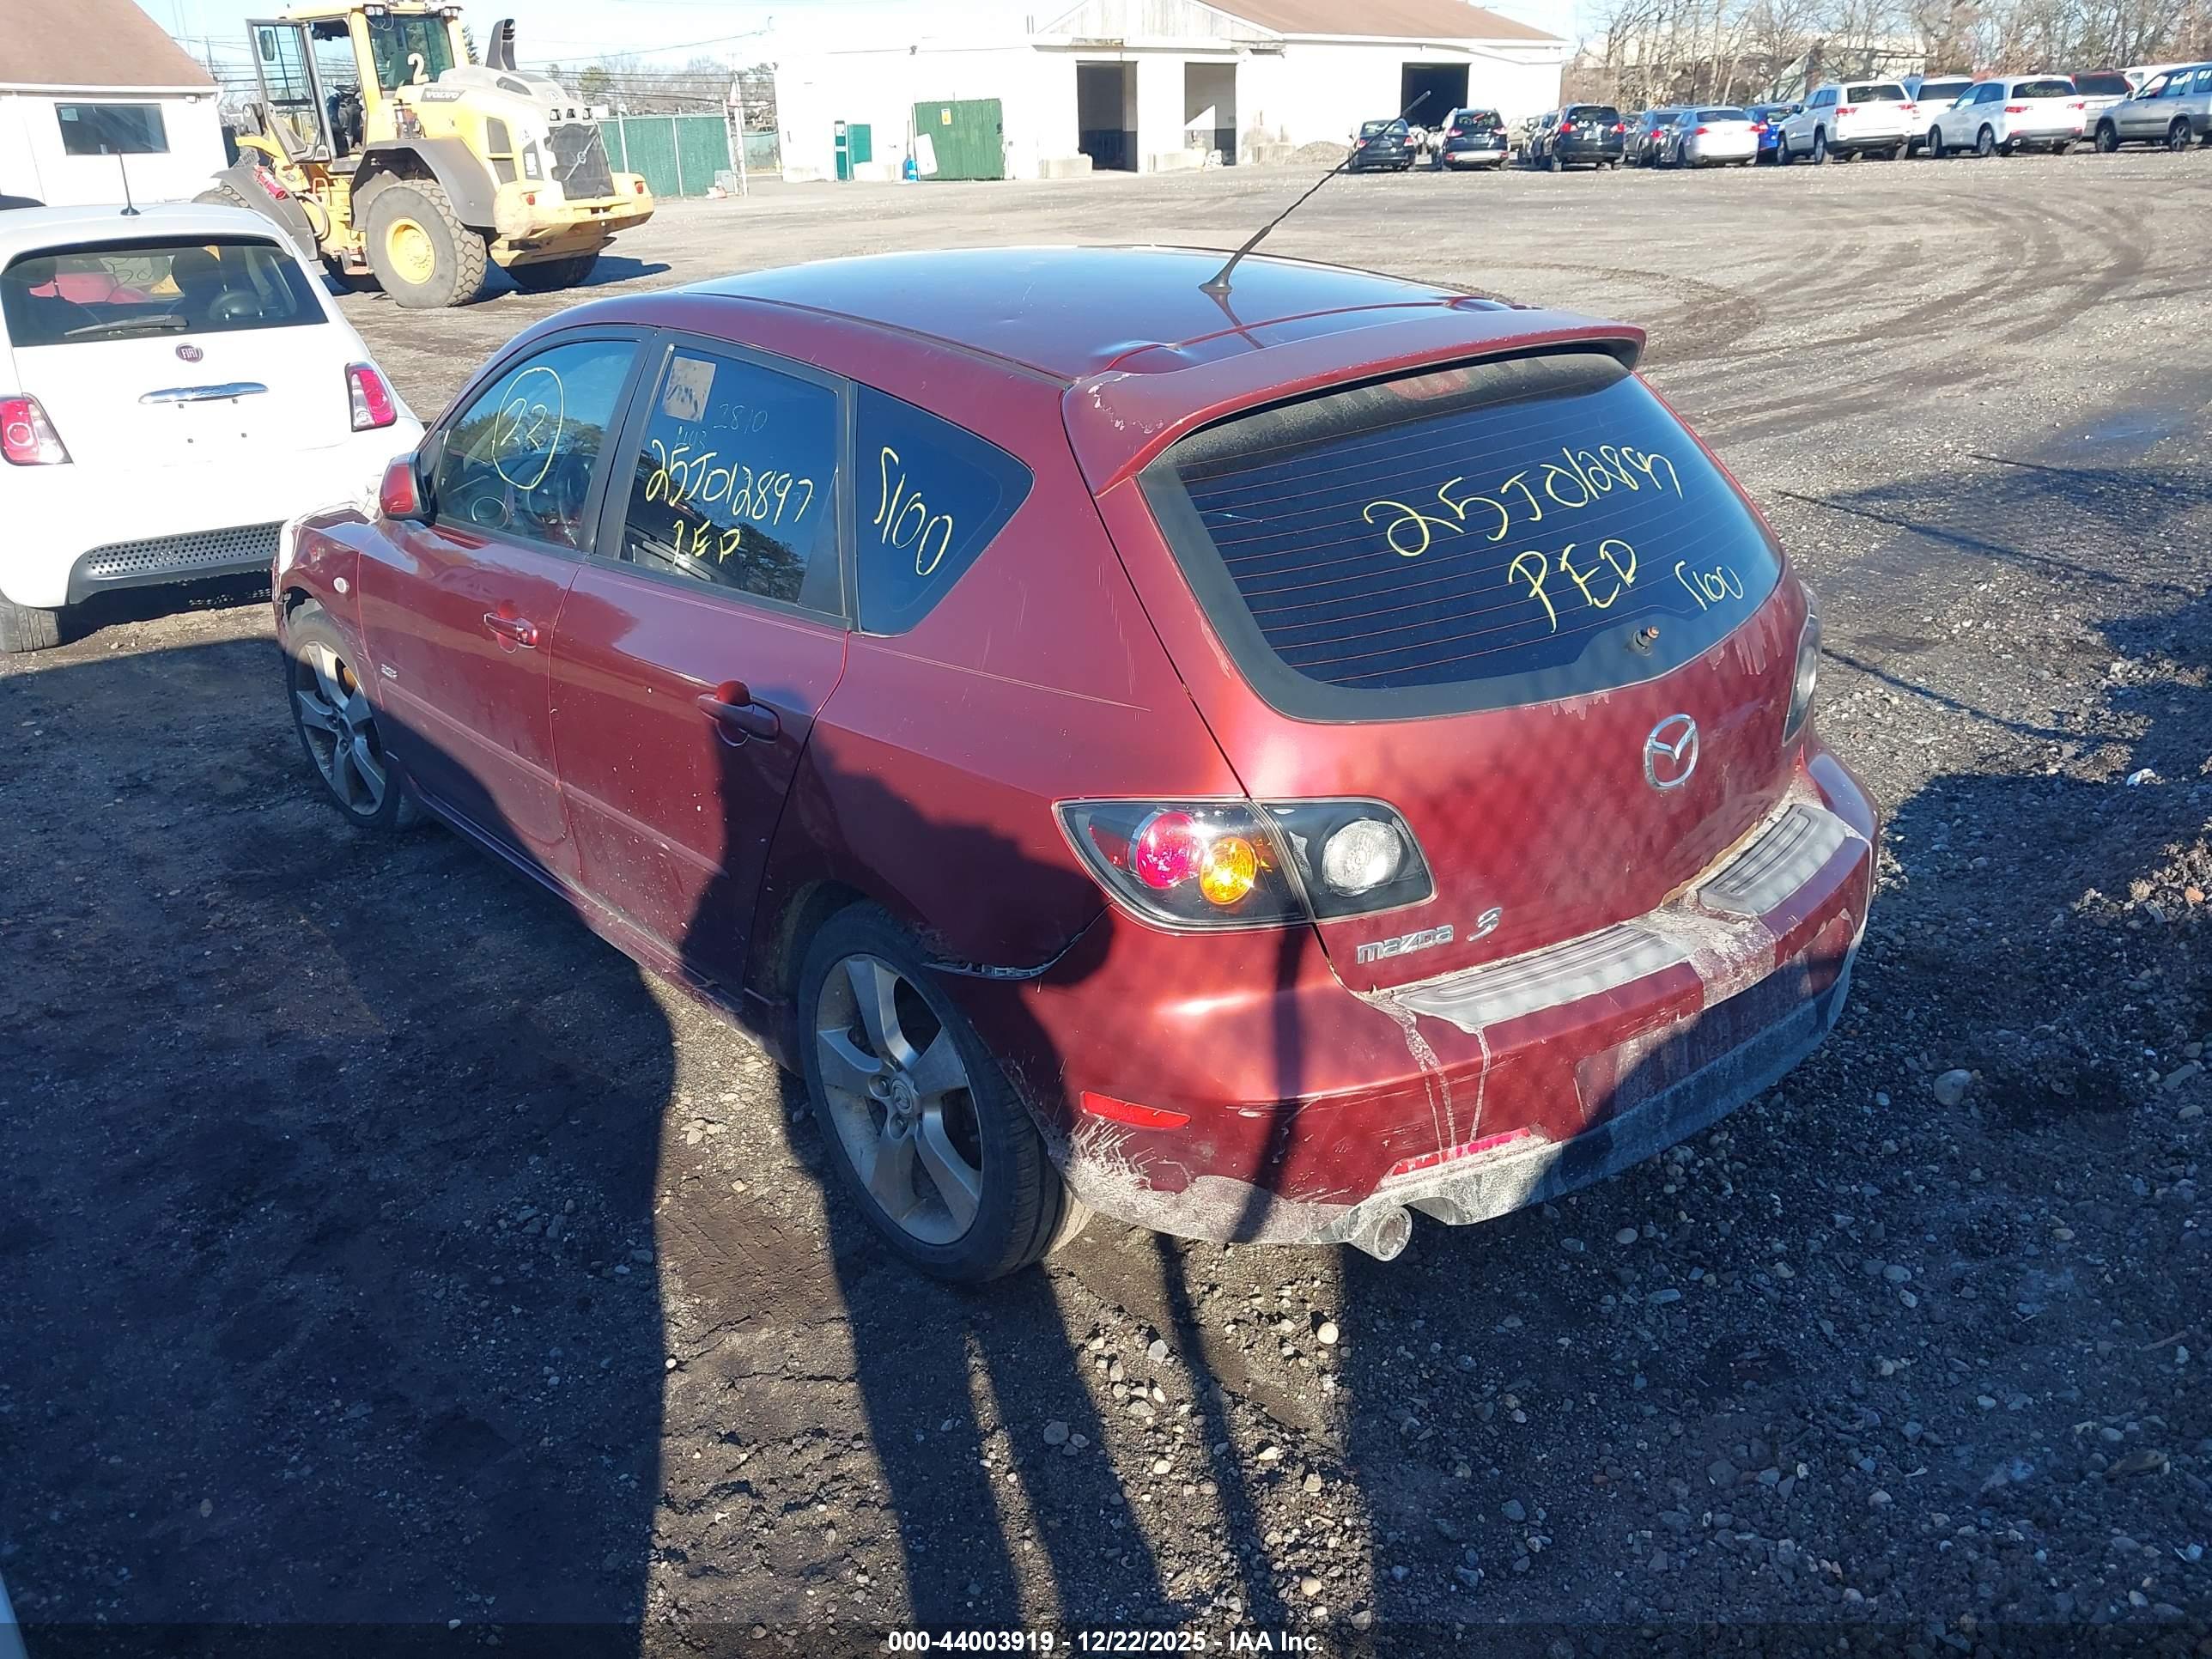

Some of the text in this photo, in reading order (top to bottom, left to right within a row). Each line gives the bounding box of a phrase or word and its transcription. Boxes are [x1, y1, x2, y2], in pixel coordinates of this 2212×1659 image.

[407, 53, 429, 84] 2
[424, 91, 460, 100] VOLVO
[179, 347, 198, 360] FIAT
